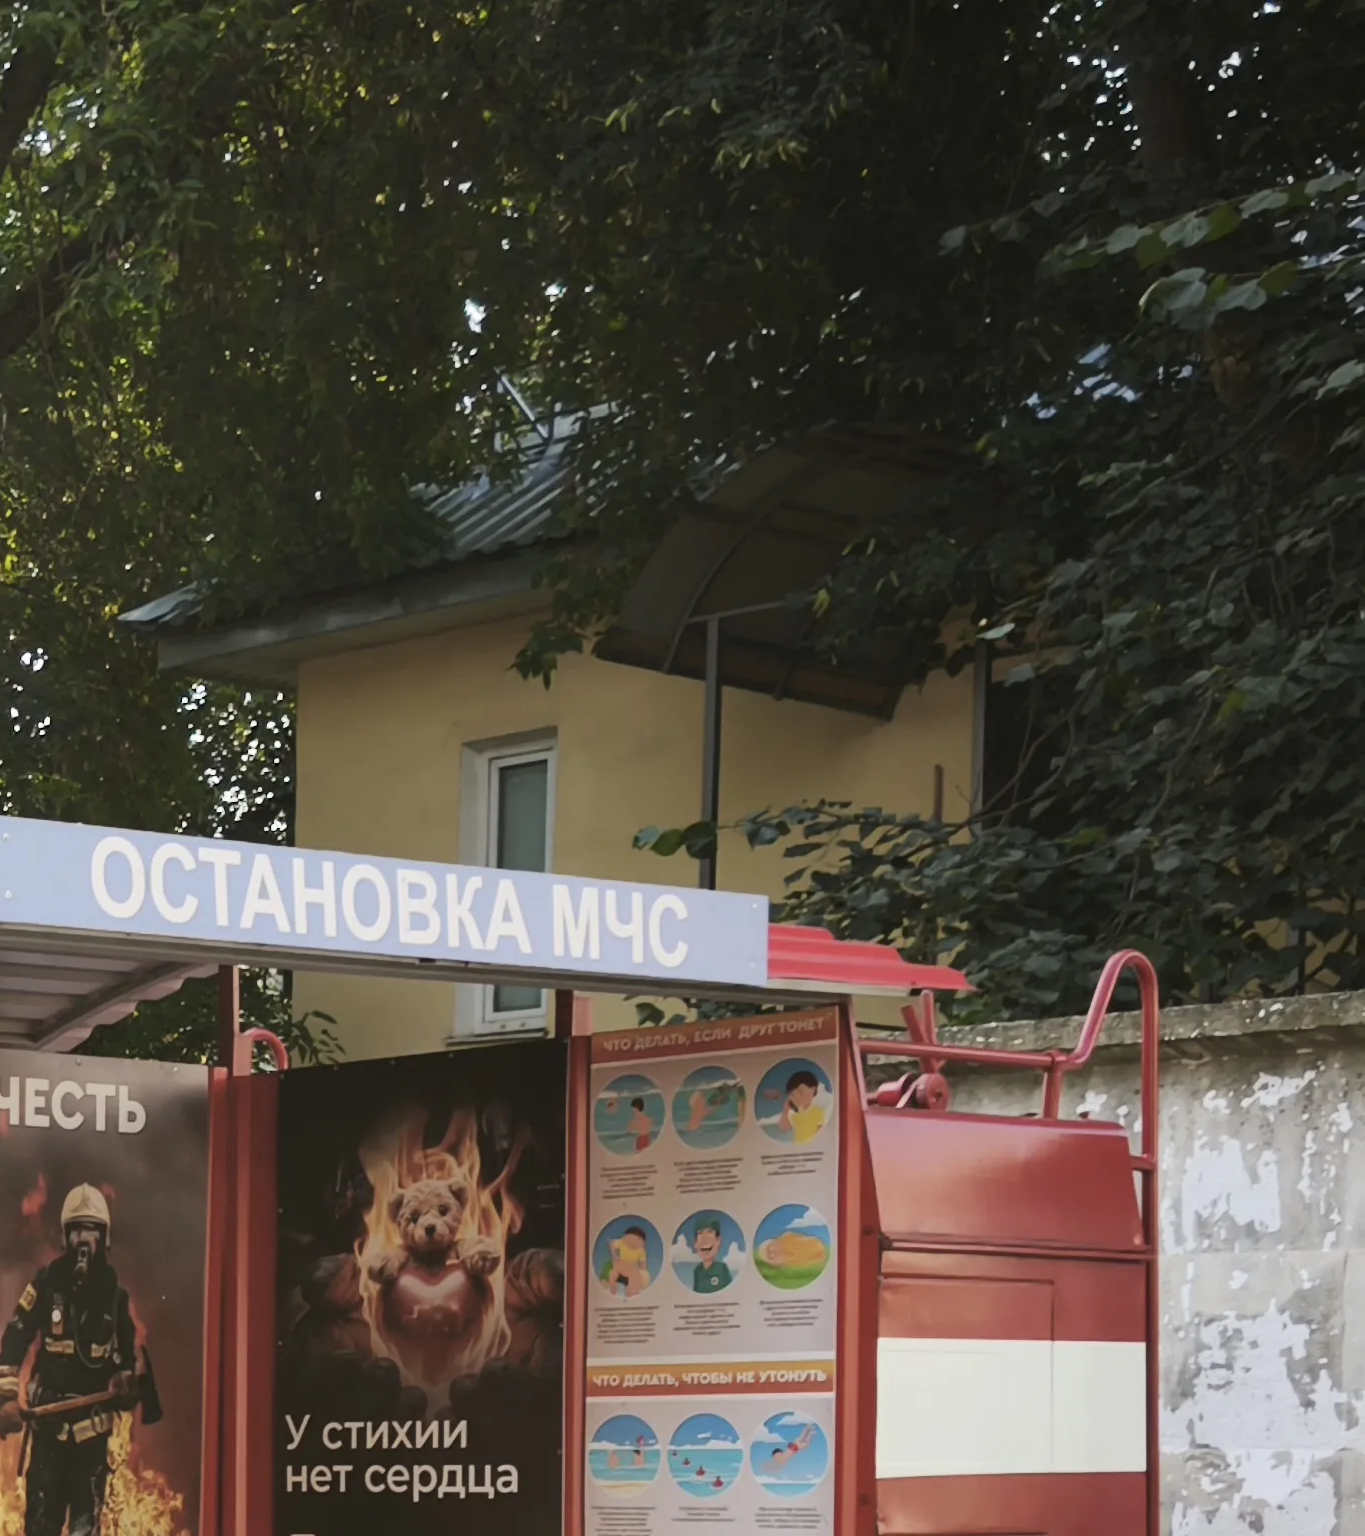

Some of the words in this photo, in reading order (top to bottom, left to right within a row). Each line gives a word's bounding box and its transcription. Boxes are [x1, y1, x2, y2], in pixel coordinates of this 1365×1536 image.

[90, 836, 532, 954] ОСТАНОВКА
[552, 884, 690, 968] МЧС
[603, 1039, 631, 1052] ЧТО
[694, 1029, 731, 1043] ЕСЛИ
[592, 1374, 619, 1387] ЧТО
[623, 1373, 679, 1388] ДЕЛАТЬ,
[682, 1371, 732, 1385] ЧТОБЫ
[736, 1371, 755, 1383] НЕ
[759, 1369, 826, 1383] УТОНУТЬ
[285, 1414, 311, 1450] У
[322, 1420, 468, 1450] стихии
[286, 1464, 353, 1492] нет
[364, 1464, 518, 1503] сердца
